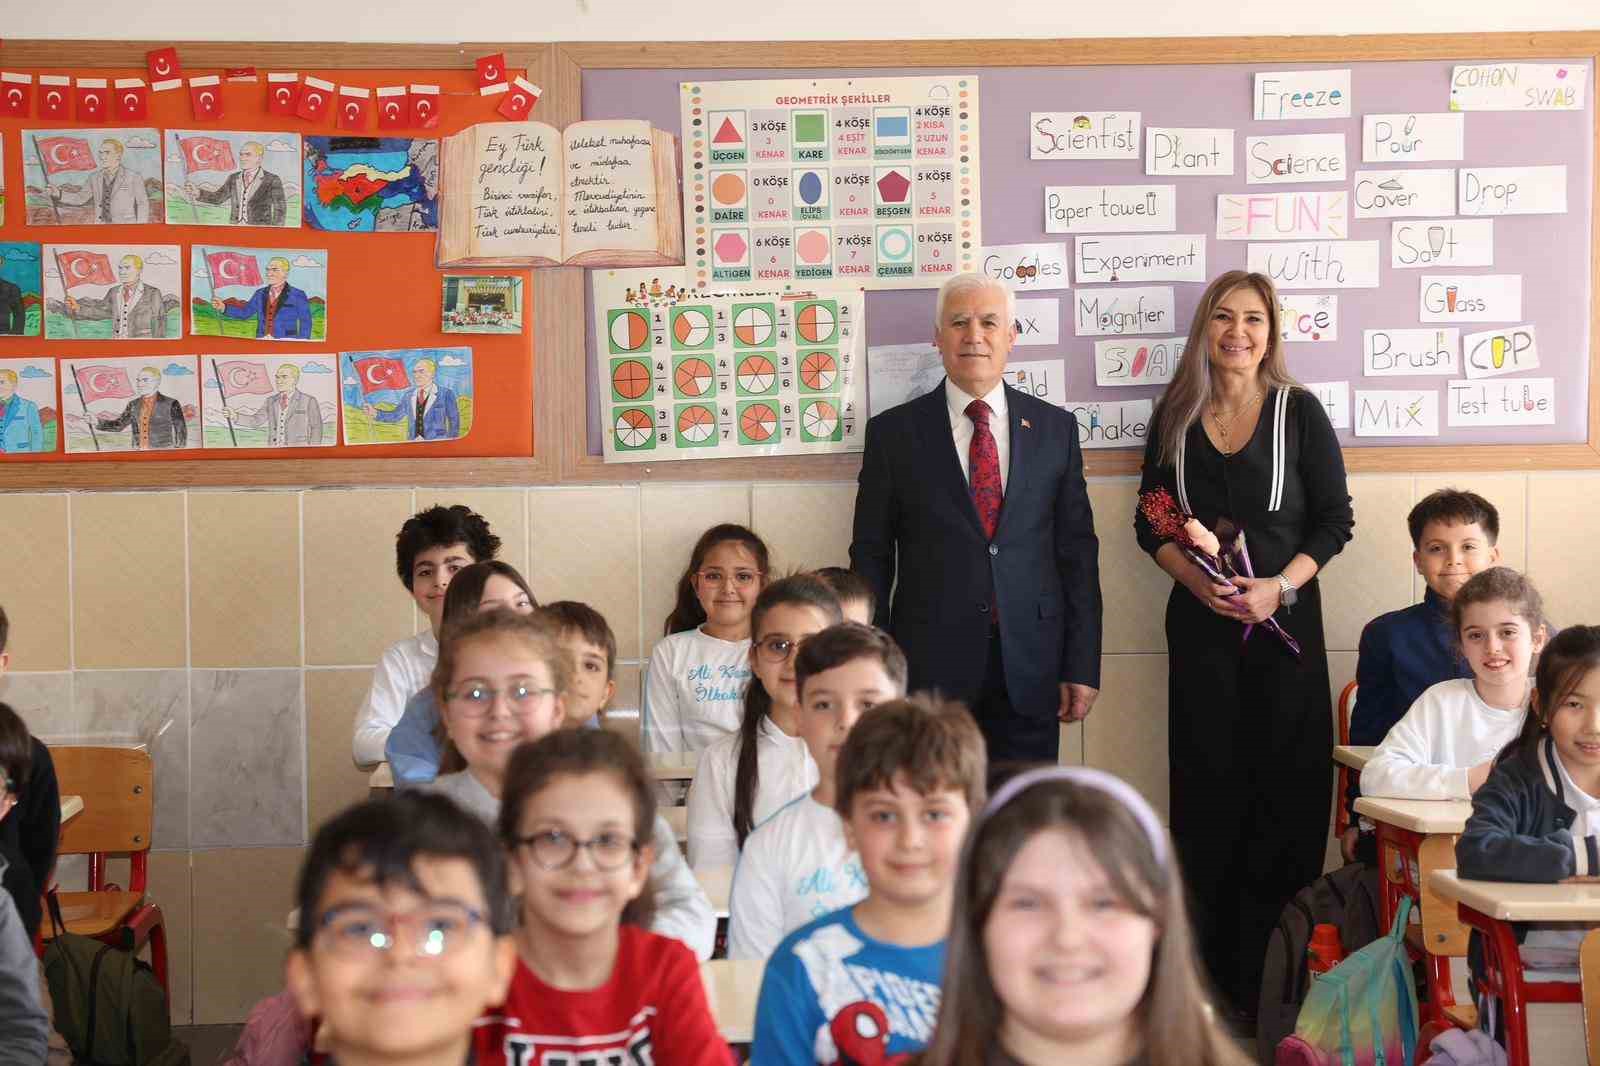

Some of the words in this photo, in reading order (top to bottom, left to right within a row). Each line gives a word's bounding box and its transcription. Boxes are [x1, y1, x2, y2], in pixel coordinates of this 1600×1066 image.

[775, 95, 838, 106] GEOMETRİK
[841, 93, 891, 107] ŞEKİLLER
[1261, 79, 1342, 120] Freeze
[1525, 88, 1576, 107] SWAB
[916, 108, 922, 116] 4
[924, 105, 951, 118] KÖŞE
[752, 123, 759, 131] 3
[761, 120, 787, 132] KÖŞE
[835, 120, 842, 128] 4
[844, 117, 870, 130] KÖŞE
[924, 134, 948, 142] UZUN
[1375, 121, 1423, 156] Pour
[486, 136, 507, 160] Ey
[512, 134, 545, 152] Türk
[838, 147, 866, 156] KENAR
[916, 148, 946, 156] KENAR
[1154, 134, 1221, 170] Plant
[712, 151, 745, 162] ÜÇGEN
[756, 150, 785, 159] KENAR
[798, 150, 824, 160] KARE
[1251, 141, 1340, 179] Science
[834, 177, 842, 185] 0
[844, 173, 870, 187] KÖŞE
[918, 172, 924, 180] 5
[926, 170, 952, 183] KÖŞE
[753, 178, 760, 186] 0
[762, 176, 789, 189] KÖŞE
[1355, 180, 1418, 210] Cover
[1466, 173, 1518, 209] Drop
[714, 209, 744, 221] DAİRE
[758, 210, 787, 219] KENAR
[840, 208, 869, 216] KENAR
[876, 208, 911, 218] BEŞGEN
[919, 206, 952, 216] KENAR
[1048, 194, 1093, 227] Paper
[1247, 196, 1321, 234] FUN
[756, 239, 762, 247] 6
[764, 236, 790, 250] KÖŞE
[838, 238, 843, 246] 7
[845, 235, 872, 248] KÖŞE
[926, 232, 953, 245] KÖŞE
[850, 250, 857, 258] 7
[932, 250, 940, 258] 0
[1081, 241, 1197, 275] Experiment
[770, 256, 776, 264] 6
[1268, 245, 1345, 283] With
[795, 268, 832, 278] YEDİGEN
[838, 264, 870, 274] KENAR
[920, 264, 953, 272] KENAR
[712, 270, 750, 279] ALTIGEN
[758, 270, 790, 279] KENAR
[1424, 282, 1487, 314] Glass
[780, 308, 786, 316] 1
[840, 306, 848, 314] 2
[1080, 296, 1165, 333] Magnifier
[655, 314, 660, 322] 1
[718, 312, 723, 320] 1
[718, 334, 725, 342] 3
[780, 330, 787, 338] 4
[655, 336, 662, 344] 2
[1371, 331, 1450, 370] Brush
[656, 362, 664, 370] 4
[720, 360, 726, 368] 4
[782, 357, 788, 365] 3
[657, 384, 665, 392] 4
[720, 382, 727, 390] 5
[782, 379, 790, 387] 6
[1452, 386, 1488, 415] Test
[1500, 385, 1548, 412] tube
[721, 408, 728, 416] 4
[784, 406, 791, 414] 6
[1360, 396, 1425, 429] Mix
[846, 425, 853, 433] 7
[1072, 406, 1146, 444] Shake
[660, 432, 668, 442] 8
[722, 430, 730, 439] 7
[785, 428, 792, 436] 7
